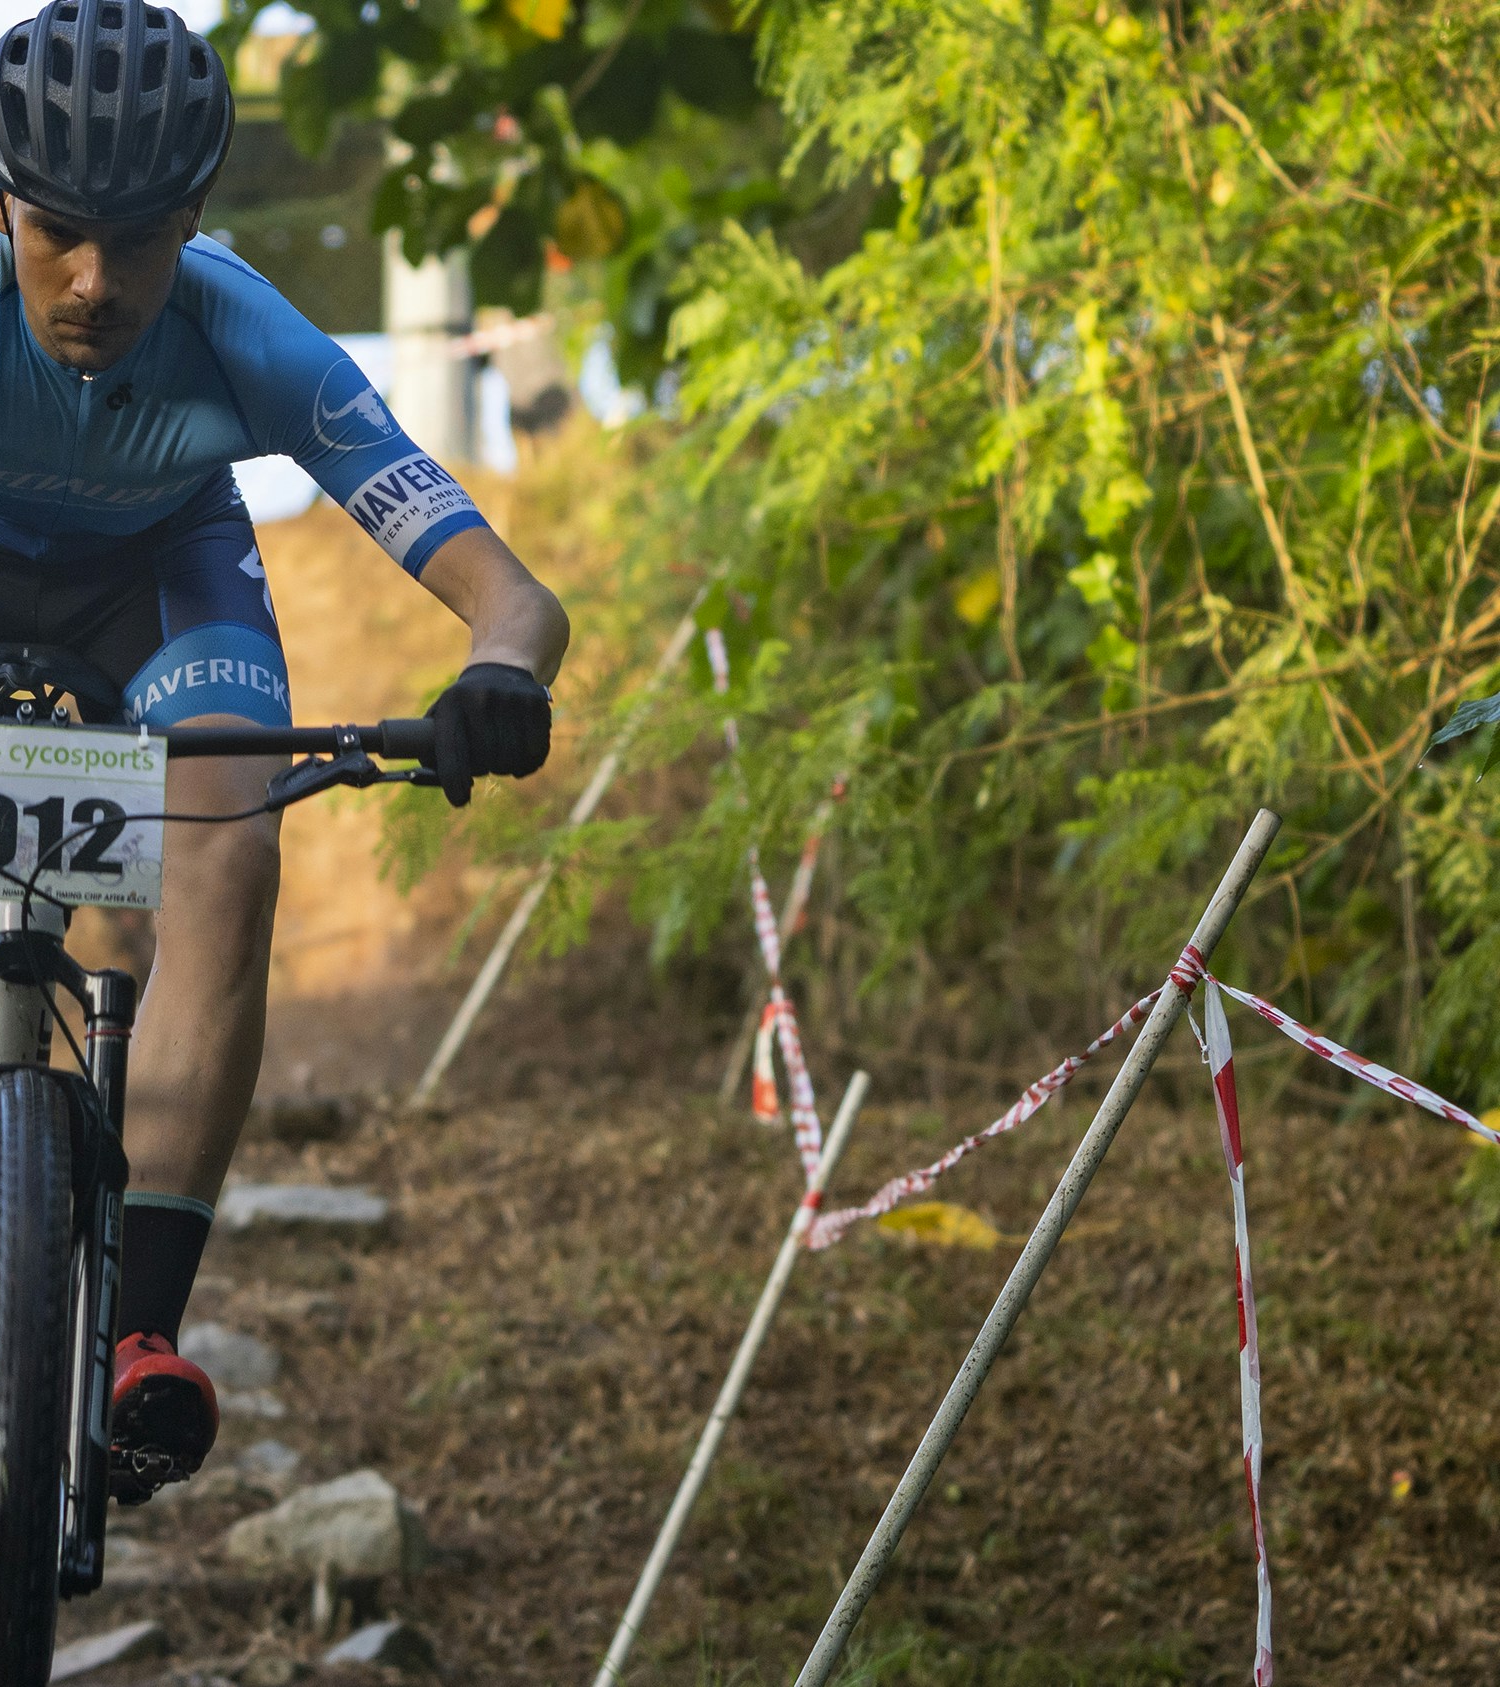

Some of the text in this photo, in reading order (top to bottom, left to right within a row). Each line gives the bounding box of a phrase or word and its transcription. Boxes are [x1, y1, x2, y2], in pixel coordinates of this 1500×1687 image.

[383, 505, 420, 545] TENTH
[122, 658, 289, 727] MAVERICK
[9, 743, 154, 774] cycosports
[84, 891, 102, 901] CHIP
[104, 893, 125, 903] AFTER
